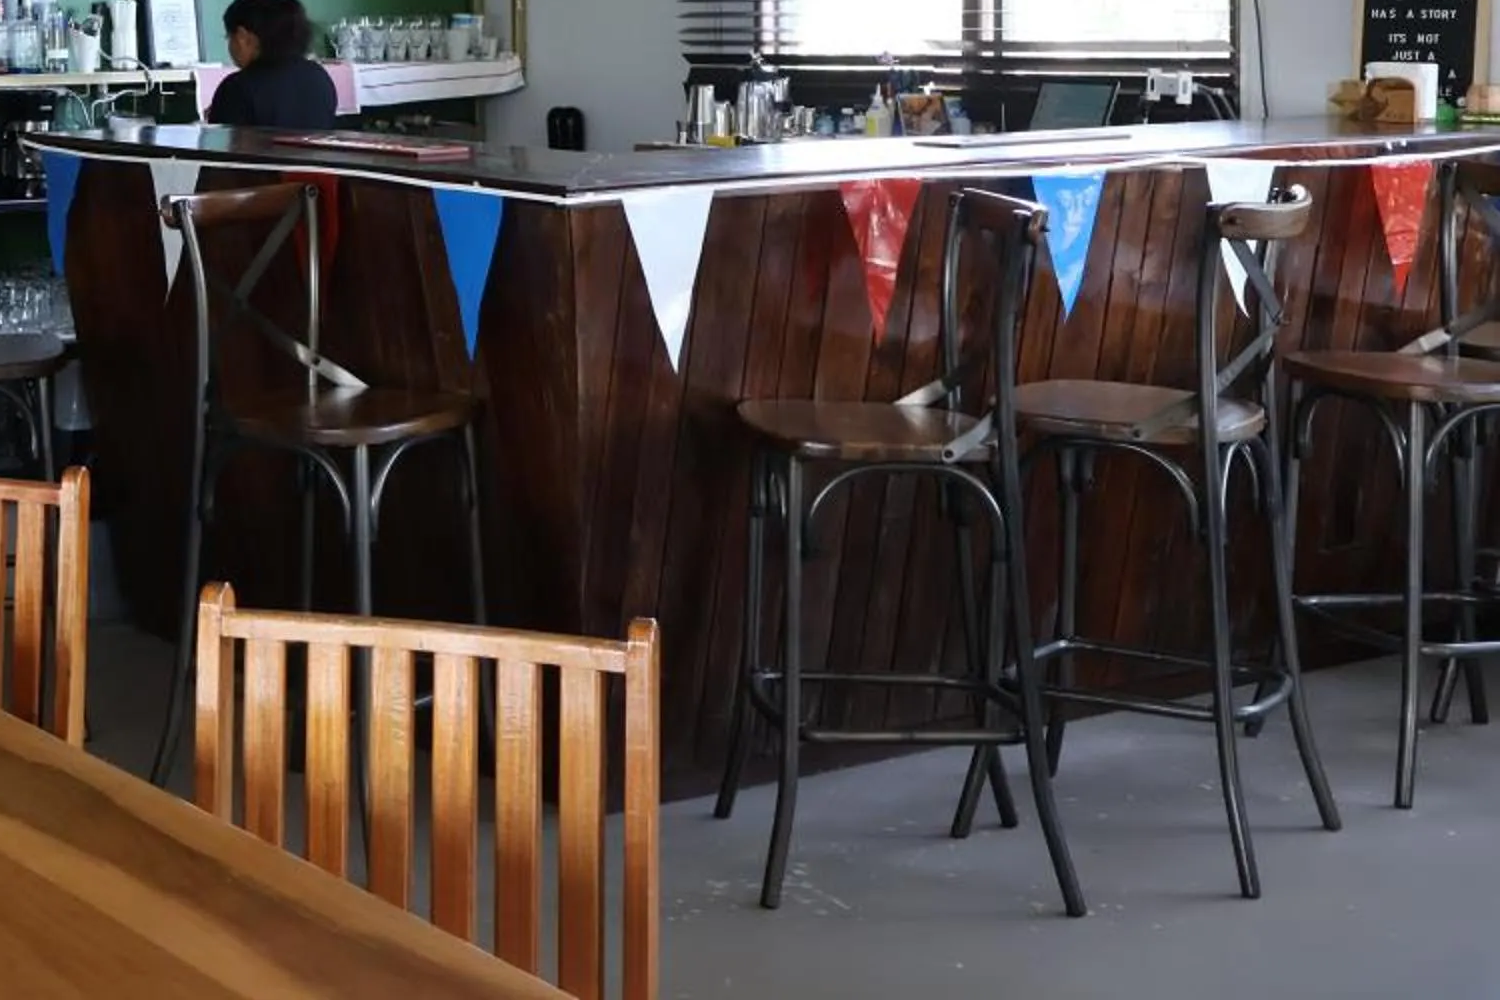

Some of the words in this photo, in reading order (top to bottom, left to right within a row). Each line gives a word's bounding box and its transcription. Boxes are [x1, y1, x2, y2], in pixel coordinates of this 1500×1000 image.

[1371, 8, 1397, 19] HAS
[1406, 8, 1414, 19] A
[1420, 9, 1457, 20] STORY
[1417, 32, 1440, 44] NOT
[1392, 50, 1420, 61] JUST
[1427, 51, 1436, 61] A
